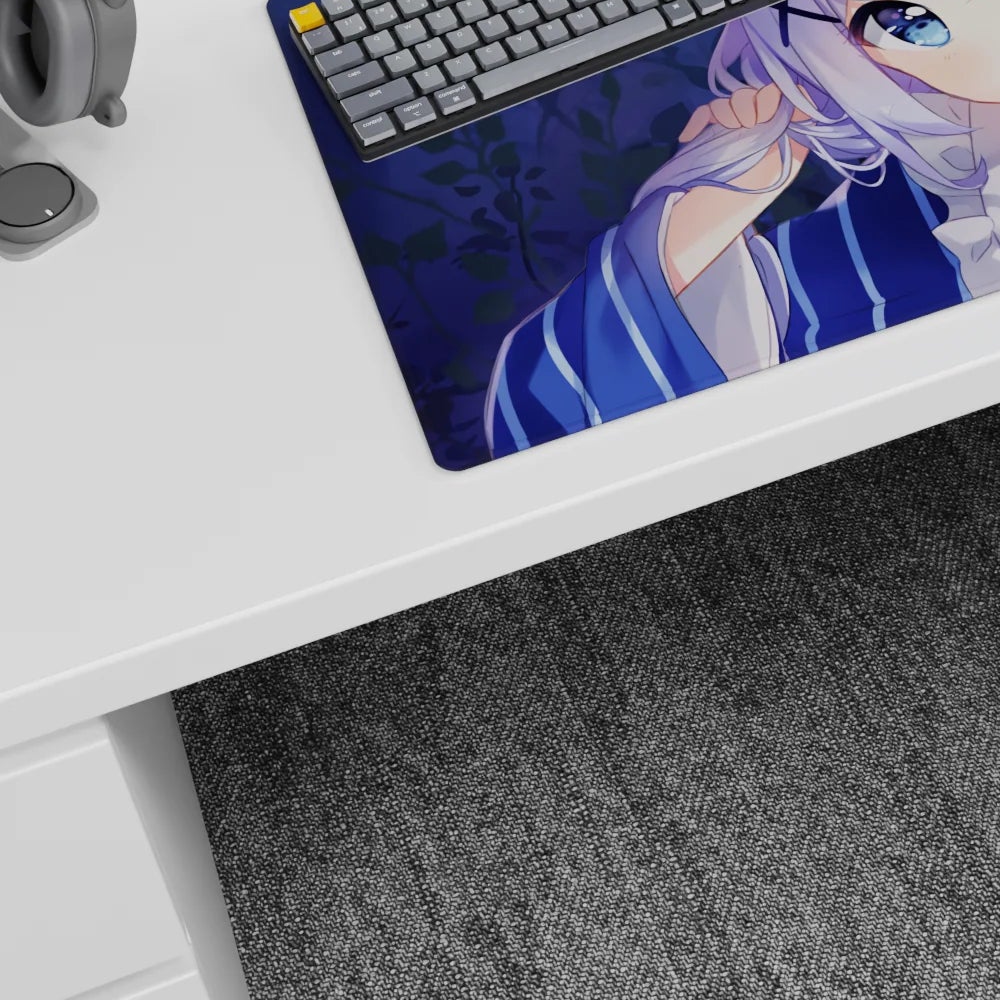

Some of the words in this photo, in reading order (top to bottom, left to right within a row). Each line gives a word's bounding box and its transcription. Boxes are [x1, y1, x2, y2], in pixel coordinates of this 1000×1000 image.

[368, 89, 383, 98] shift
[438, 84, 467, 99] command
[403, 102, 423, 113] option
[362, 116, 383, 128] control
